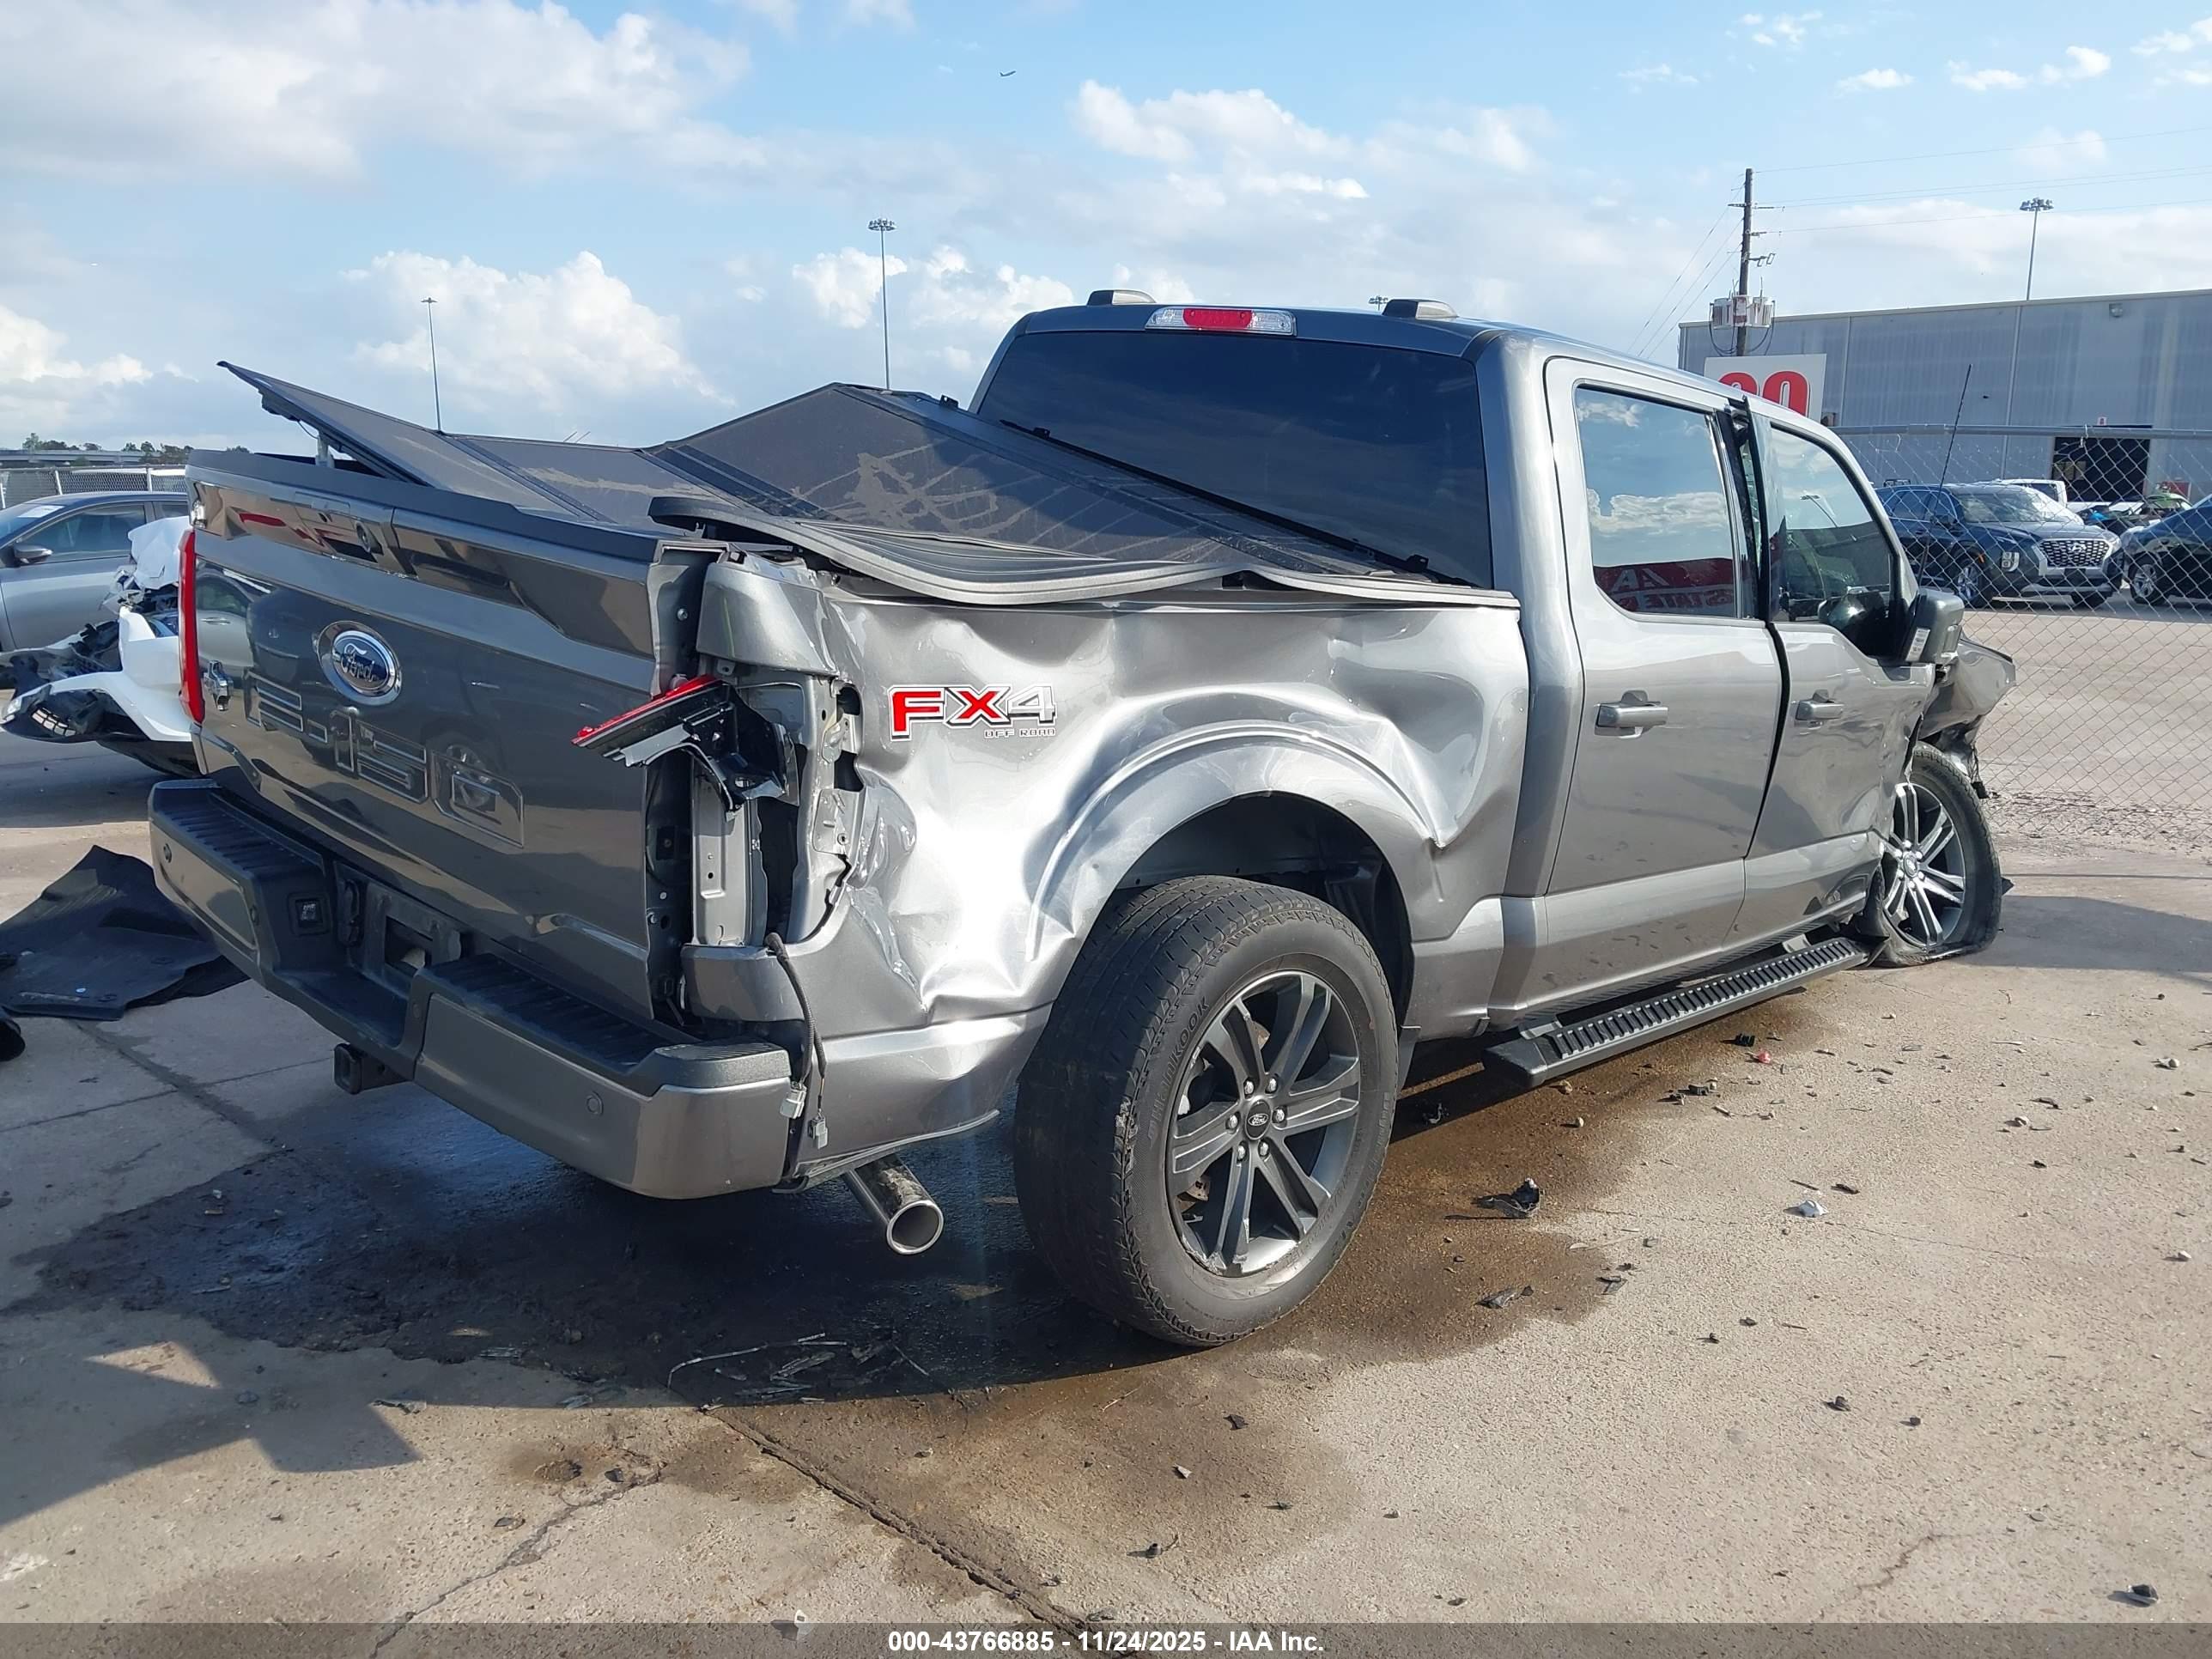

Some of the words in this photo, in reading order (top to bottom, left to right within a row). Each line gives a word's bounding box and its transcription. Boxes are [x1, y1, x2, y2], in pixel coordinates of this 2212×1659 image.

[887, 684, 1057, 741] FX4
[984, 727, 1015, 739] OFF
[1019, 726, 1056, 738] ROAD
[244, 671, 525, 848] F-150
